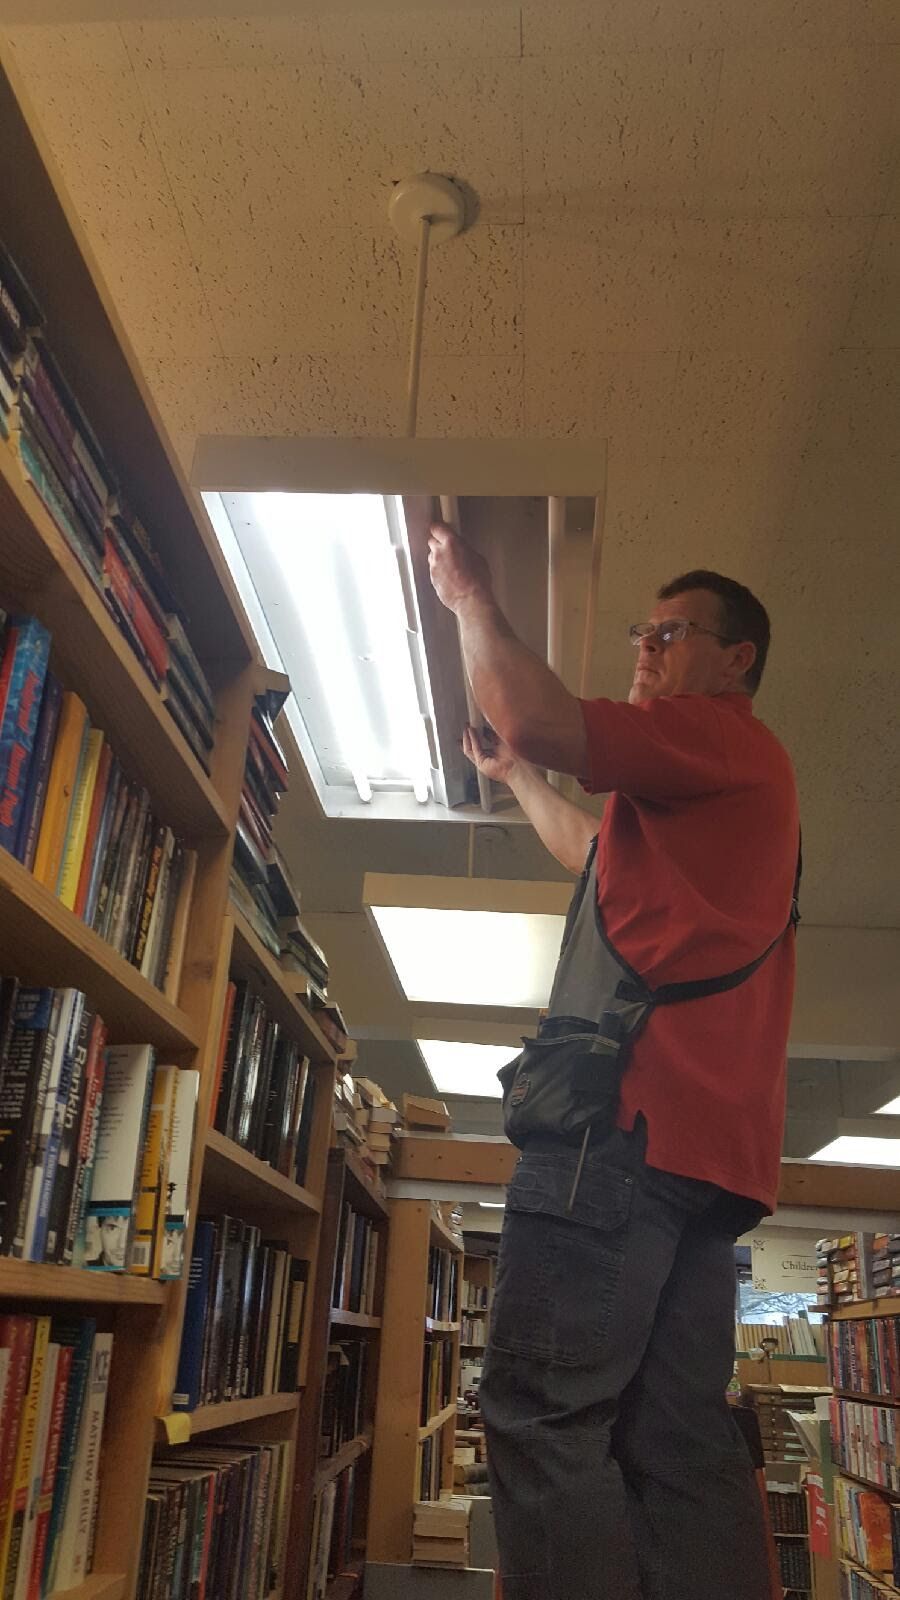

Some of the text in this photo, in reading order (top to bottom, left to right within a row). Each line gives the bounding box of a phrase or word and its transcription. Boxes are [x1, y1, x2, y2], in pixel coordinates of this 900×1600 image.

[64, 1010, 92, 1130] Ian Rankin
[21, 1356, 44, 1483] KATHY REICHS
[79, 1411, 100, 1534] MATTHEW REILLY
